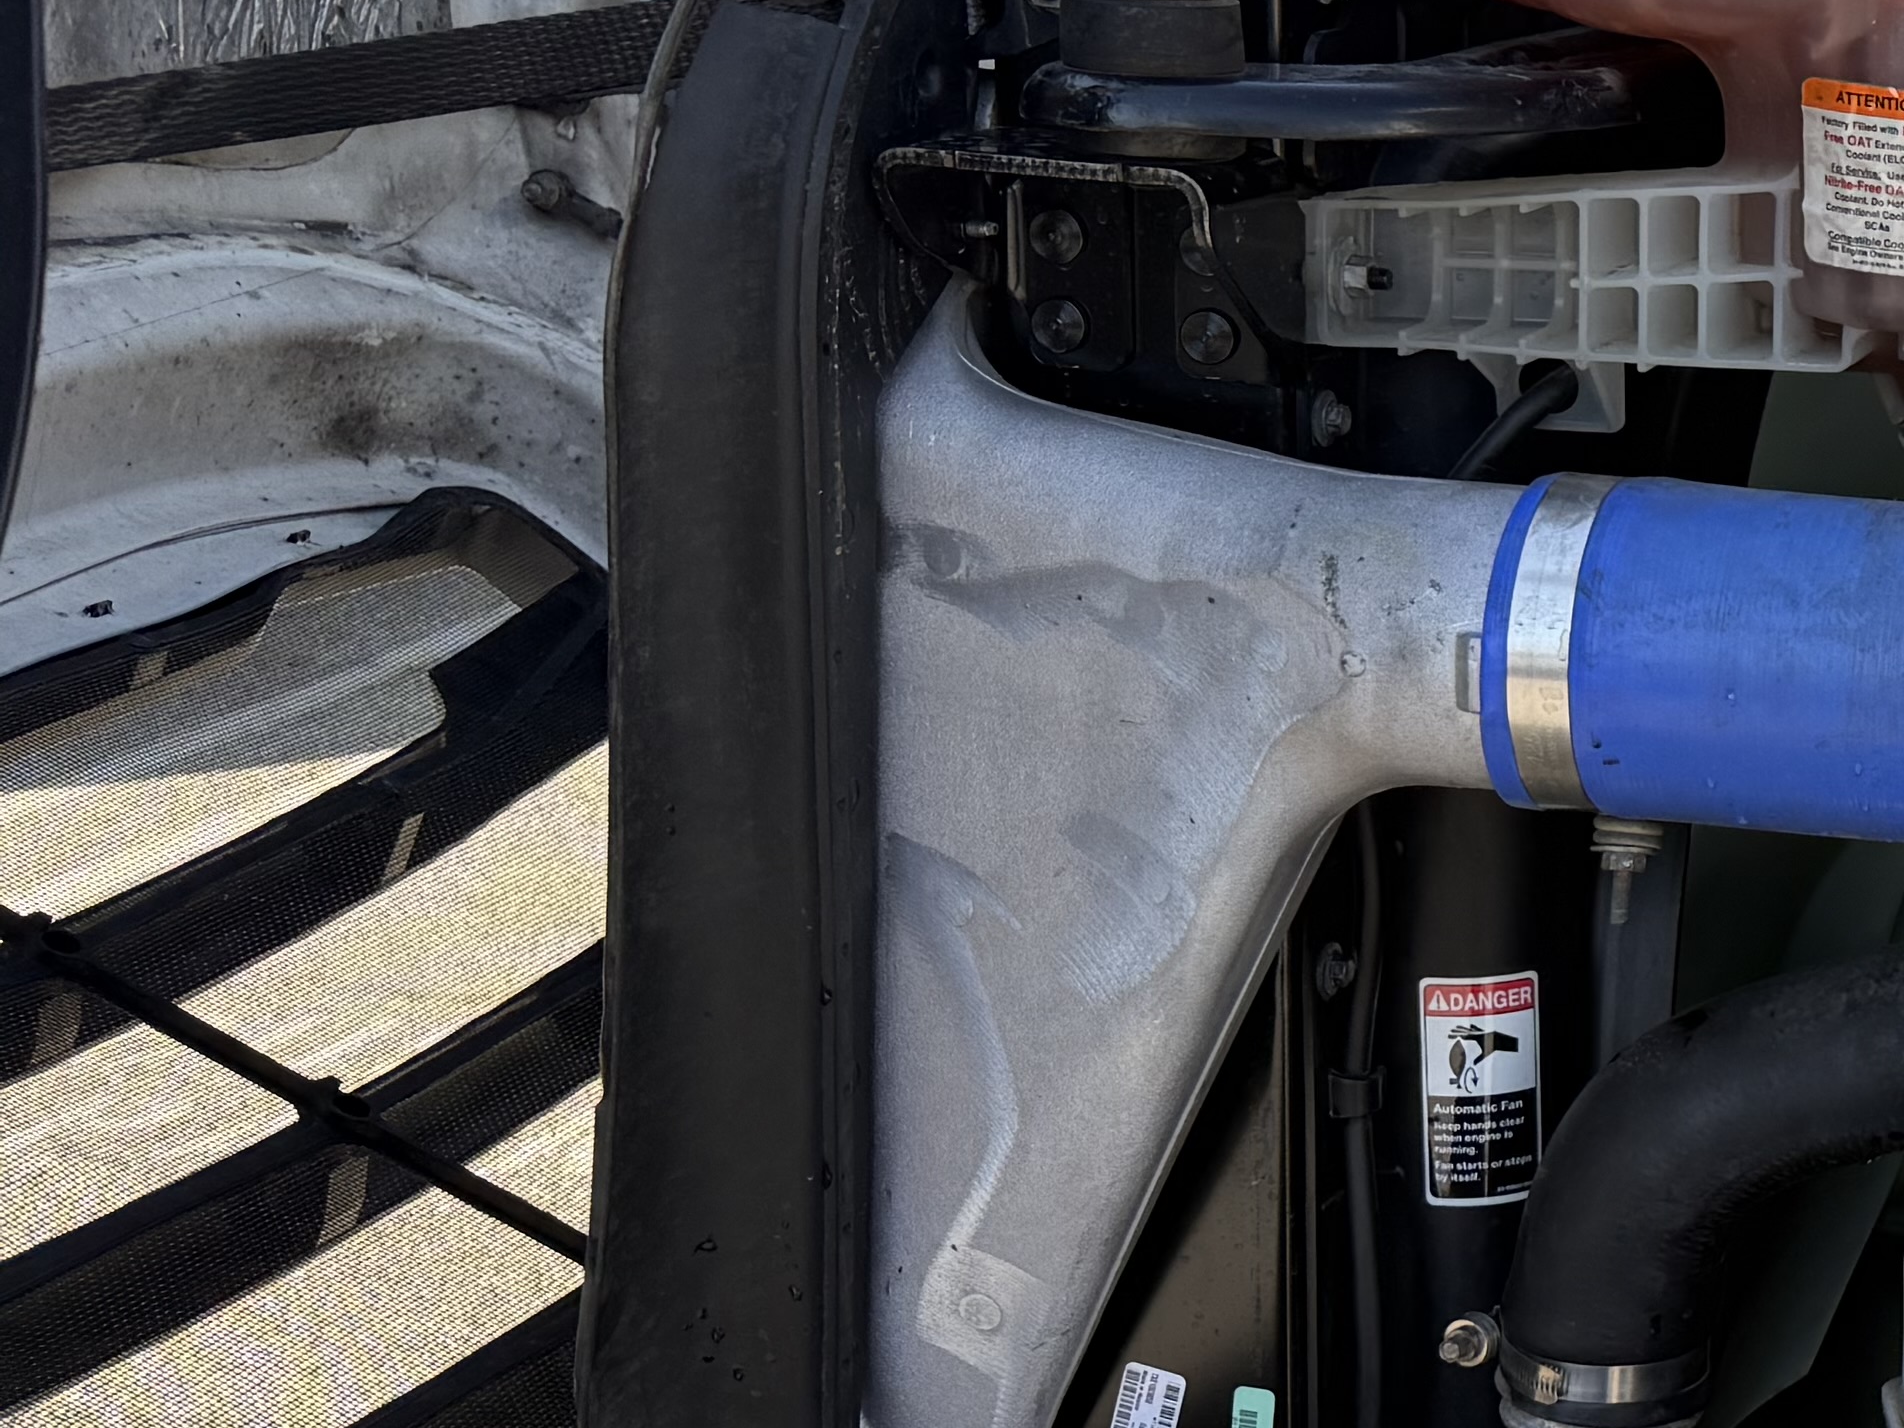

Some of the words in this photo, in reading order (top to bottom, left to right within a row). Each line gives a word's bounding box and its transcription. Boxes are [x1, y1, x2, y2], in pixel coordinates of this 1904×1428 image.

[1824, 130, 1844, 144] Free
[1847, 134, 1873, 149] OAT
[1845, 149, 1881, 163] Coolant
[1824, 175, 1882, 195] Nitrite-Free
[1871, 196, 1884, 207] Do
[1828, 229, 1882, 247] Compatible
[1450, 986, 1532, 1012] DANGER
[1433, 1102, 1498, 1115] Automatic
[1501, 1098, 1523, 1112] Fan
[1434, 1120, 1461, 1133] Keep
[1463, 1119, 1497, 1130] hands
[1499, 1116, 1525, 1128] clear
[1434, 1132, 1462, 1143] when
[1464, 1131, 1502, 1145] engine
[1504, 1130, 1513, 1140] is
[1434, 1143, 1479, 1157] running.
[1434, 1159, 1454, 1170] Fan
[1456, 1158, 1489, 1170] starts
[1490, 1159, 1503, 1169] or
[1505, 1155, 1532, 1169] stops
[1435, 1172, 1448, 1184] by
[1450, 1171, 1481, 1183] itself.
